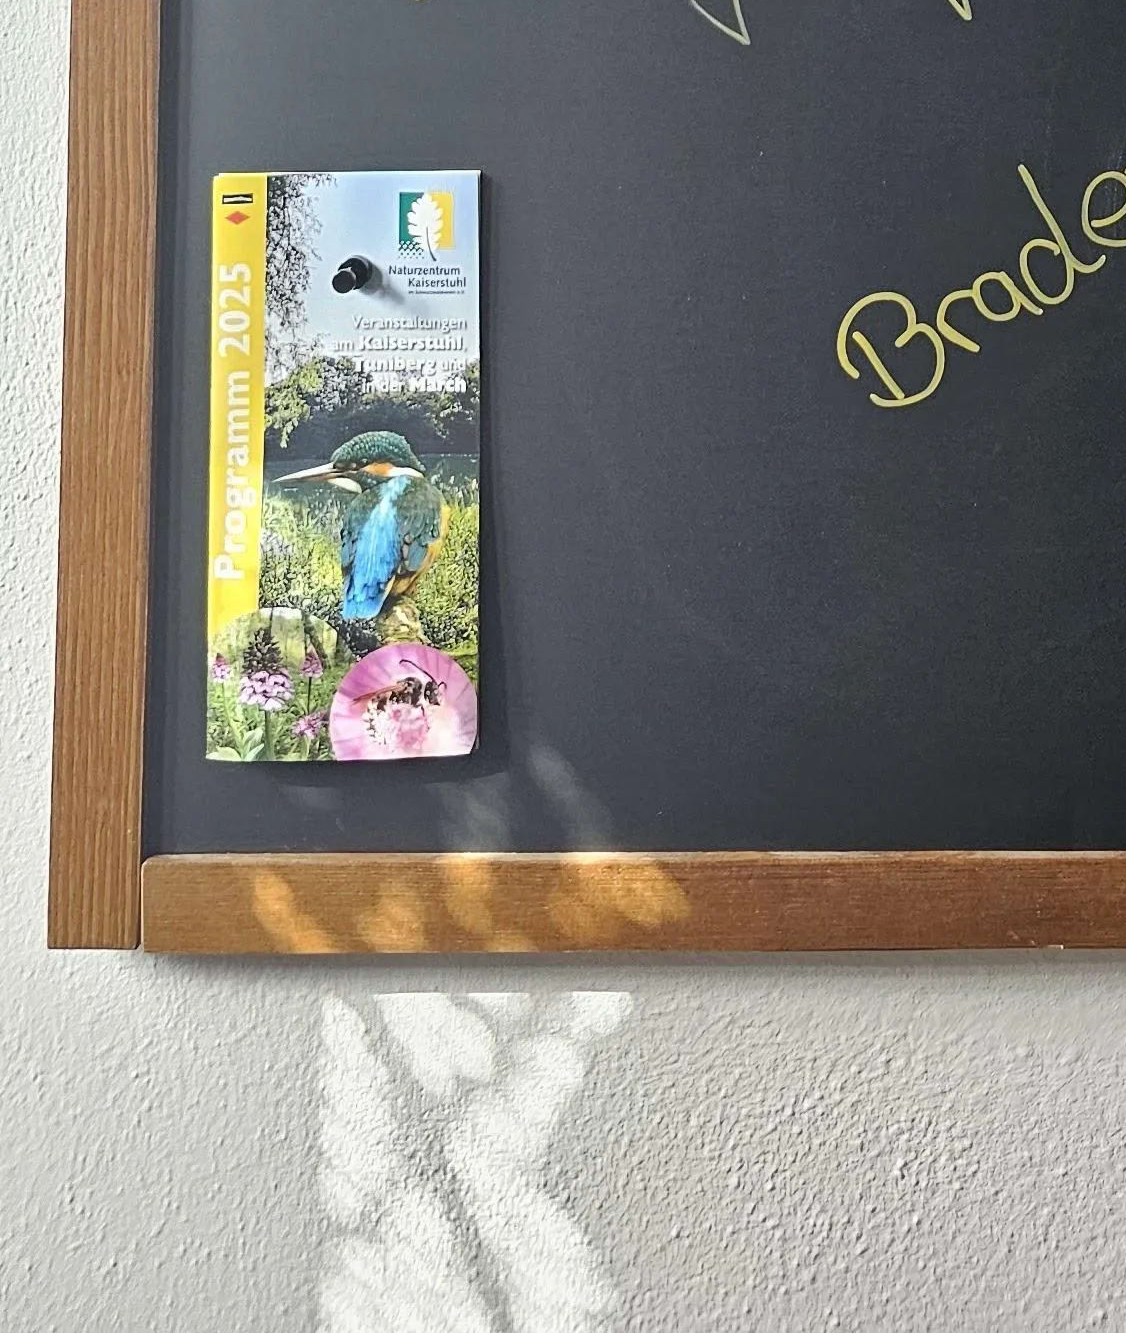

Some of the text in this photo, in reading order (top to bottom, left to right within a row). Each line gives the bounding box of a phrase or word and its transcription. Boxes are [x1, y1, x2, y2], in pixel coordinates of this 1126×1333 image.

[388, 264, 461, 276] Naturzentrum
[408, 276, 467, 288] Kaiserstuhl
[352, 315, 467, 334] Veranstaltungen
[331, 339, 354, 352] am
[353, 356, 467, 376] Tuniberg und
[408, 374, 468, 393] March
[213, 262, 257, 581] Programm 2025
